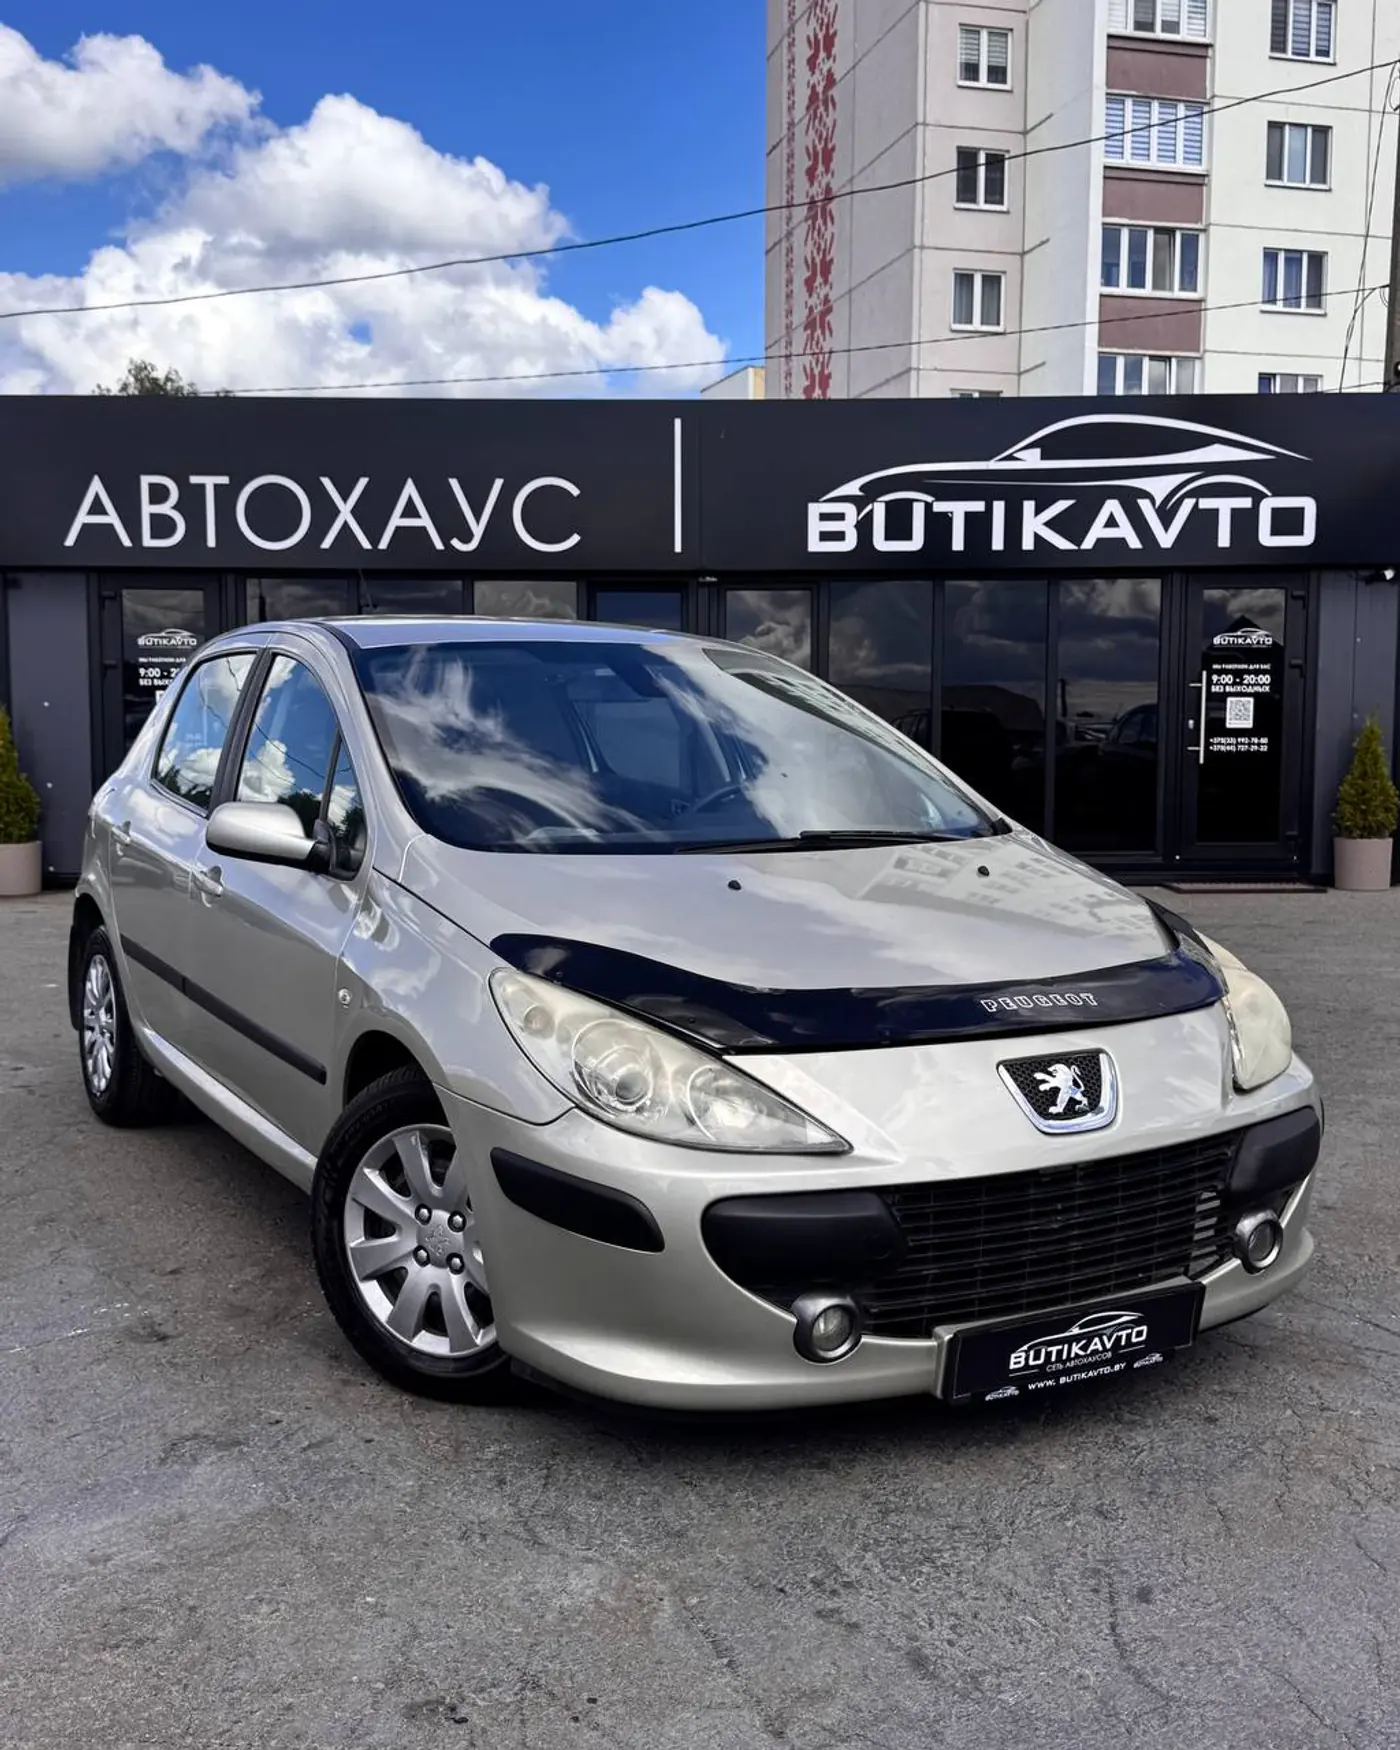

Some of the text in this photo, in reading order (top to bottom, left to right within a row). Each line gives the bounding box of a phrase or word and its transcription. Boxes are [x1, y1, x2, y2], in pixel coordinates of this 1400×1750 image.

[64, 474, 582, 553] АВТОХАУС
[806, 495, 1318, 553] BUTIKAVTO
[139, 668, 161, 678] 9:00
[1211, 674, 1233, 685] 9:00
[1242, 674, 1271, 685] 20:00
[1211, 685, 1270, 693] БЕЗ ВЫХОДНЫХ
[980, 992, 1099, 1013] PEUGEOT
[1008, 1324, 1149, 1371] BUTIKAVTO
[1046, 1351, 1113, 1373] СЕТЬ АВТОХАУСОВ
